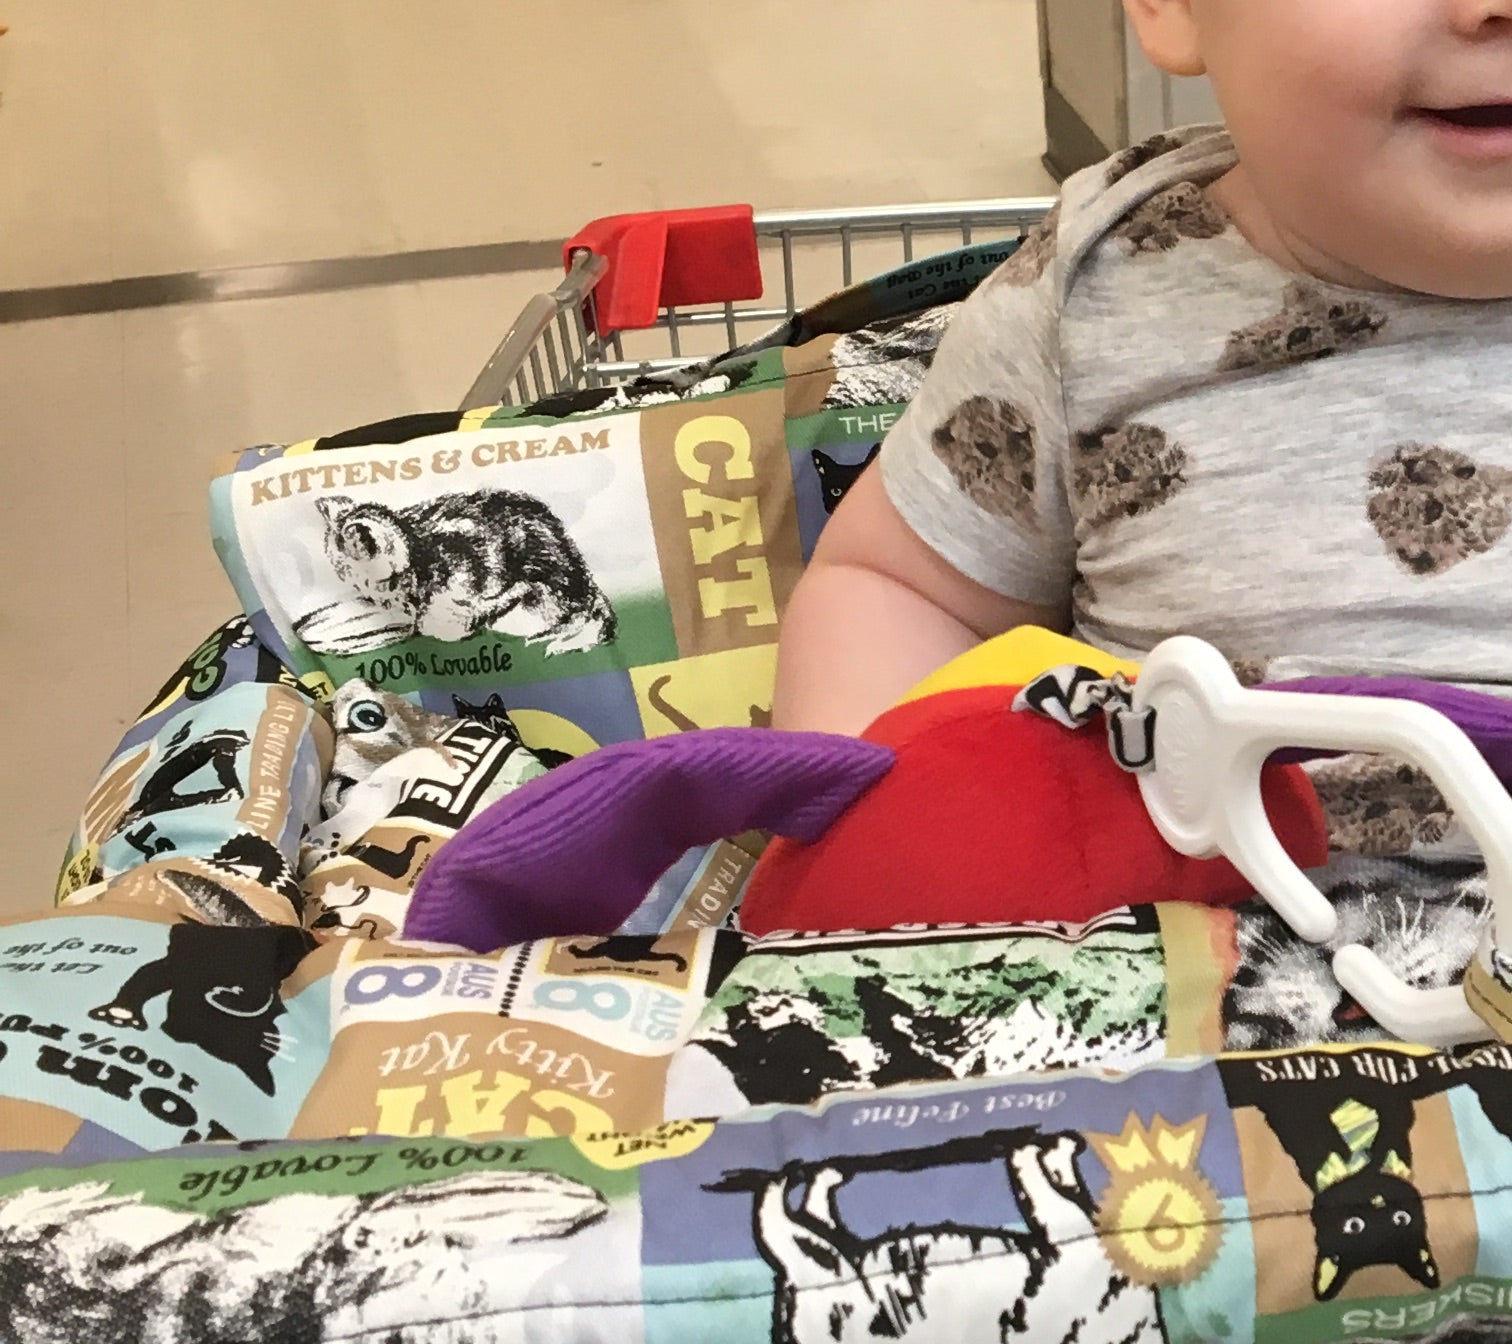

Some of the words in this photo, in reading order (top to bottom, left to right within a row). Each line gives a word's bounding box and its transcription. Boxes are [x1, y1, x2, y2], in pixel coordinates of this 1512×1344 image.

[838, 414, 898, 437] THE
[250, 456, 422, 506] KITTENS
[432, 449, 462, 476] &
[472, 428, 610, 468] CREAM
[674, 415, 778, 627] CAT
[356, 650, 427, 686] 100%
[431, 647, 512, 678] Lovable
[261, 720, 295, 786] TRADING
[2, 941, 48, 958] the
[44, 937, 85, 956] of
[88, 942, 139, 957] out
[51, 962, 103, 975] Let
[457, 962, 499, 1001] AUS
[645, 990, 686, 1043] AUS
[79, 1032, 200, 1096] 100%
[377, 1031, 472, 1078] Kat
[486, 1027, 616, 1099] Kitty
[1256, 1056, 1342, 1084] CATS
[1352, 1053, 1420, 1086] FOR
[851, 1101, 970, 1128] Feline
[985, 1088, 1068, 1116] Best
[398, 1143, 531, 1175] 100%
[180, 1153, 384, 1204] Lovable
